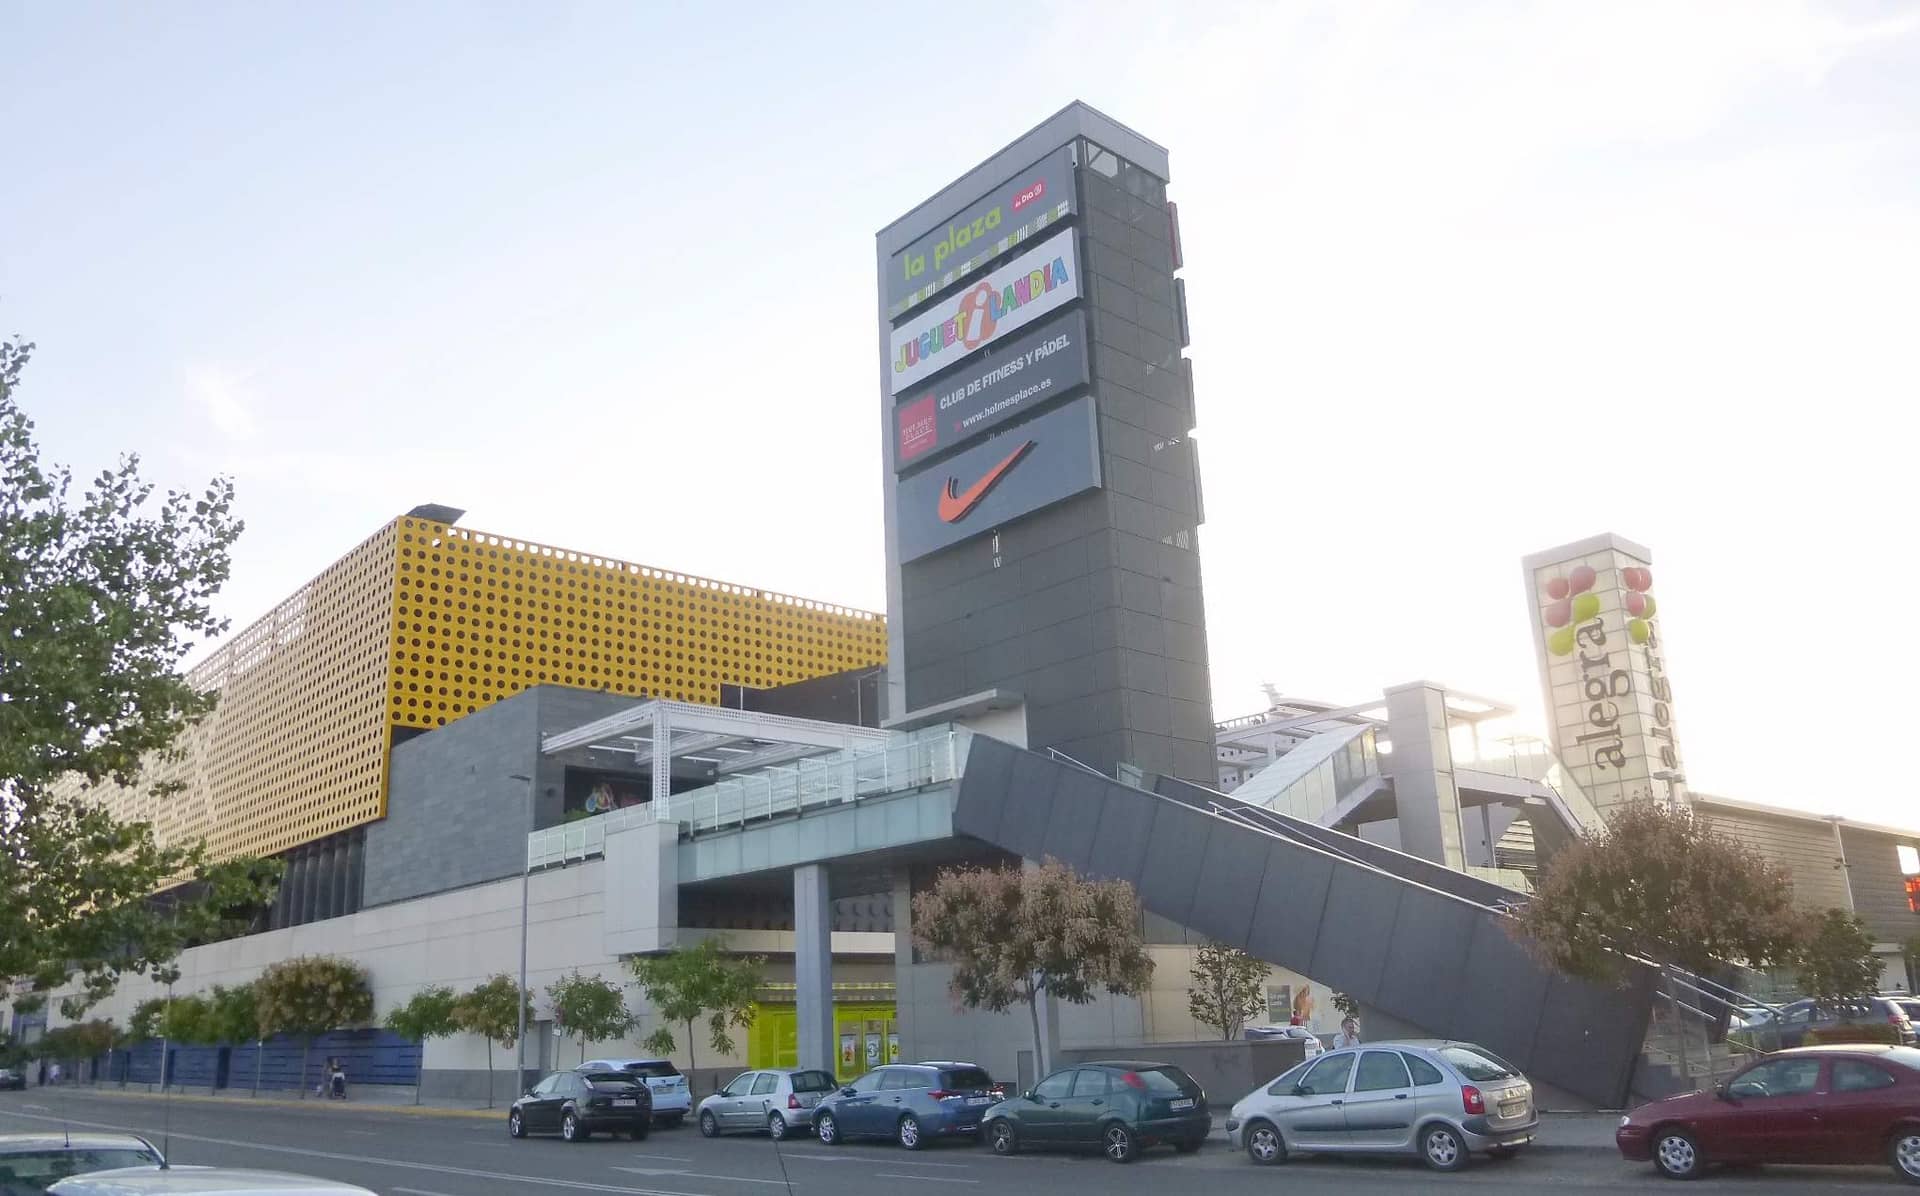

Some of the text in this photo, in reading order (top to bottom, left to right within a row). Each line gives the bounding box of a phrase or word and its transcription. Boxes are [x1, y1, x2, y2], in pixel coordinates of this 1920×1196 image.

[903, 205, 1001, 281] la plaza
[939, 334, 1071, 410] CLUB DE FITNESS Y PÁDEL
[962, 378, 1052, 428] www.holmesplace.es
[1576, 617, 1631, 771] alegra
